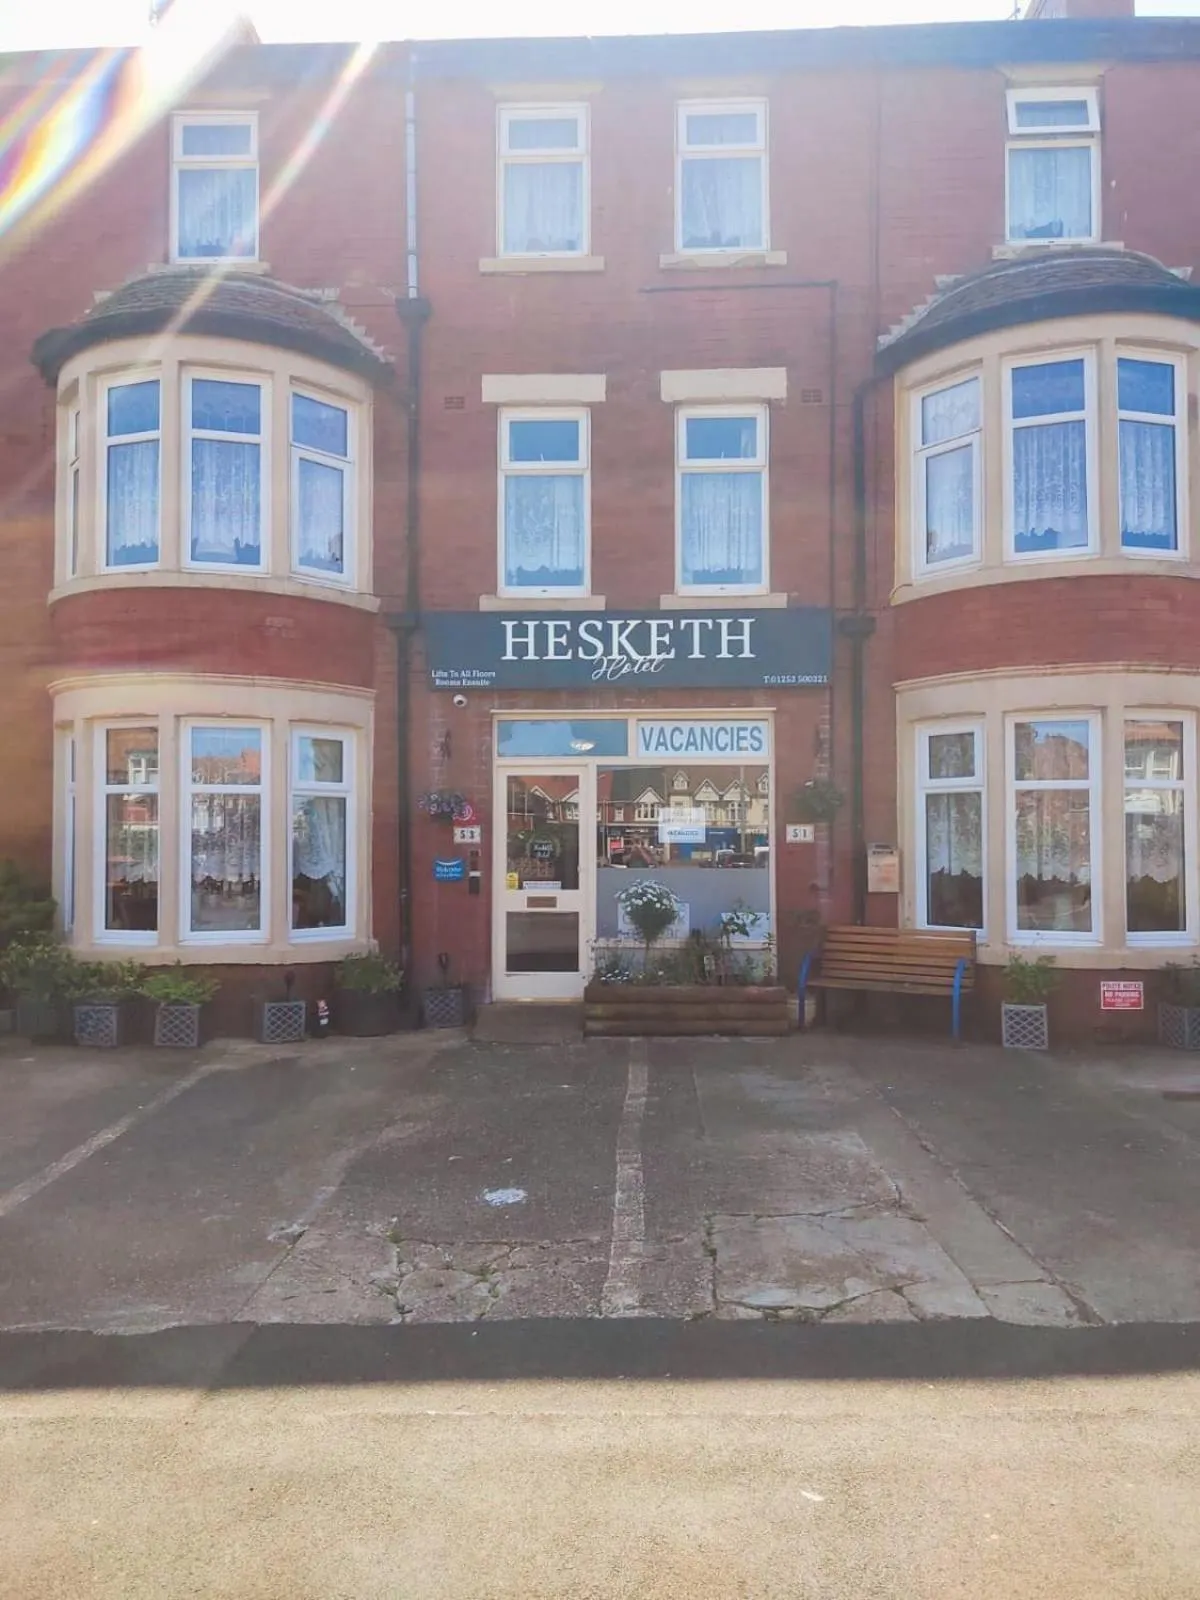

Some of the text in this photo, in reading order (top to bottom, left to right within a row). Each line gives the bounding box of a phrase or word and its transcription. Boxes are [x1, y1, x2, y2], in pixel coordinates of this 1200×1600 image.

[501, 618, 756, 660] HESKETH
[450, 669, 459, 678] To
[460, 669, 471, 678] All
[472, 669, 496, 678] Floors
[591, 652, 665, 681] Hotel
[641, 726, 763, 752] VACANCIES
